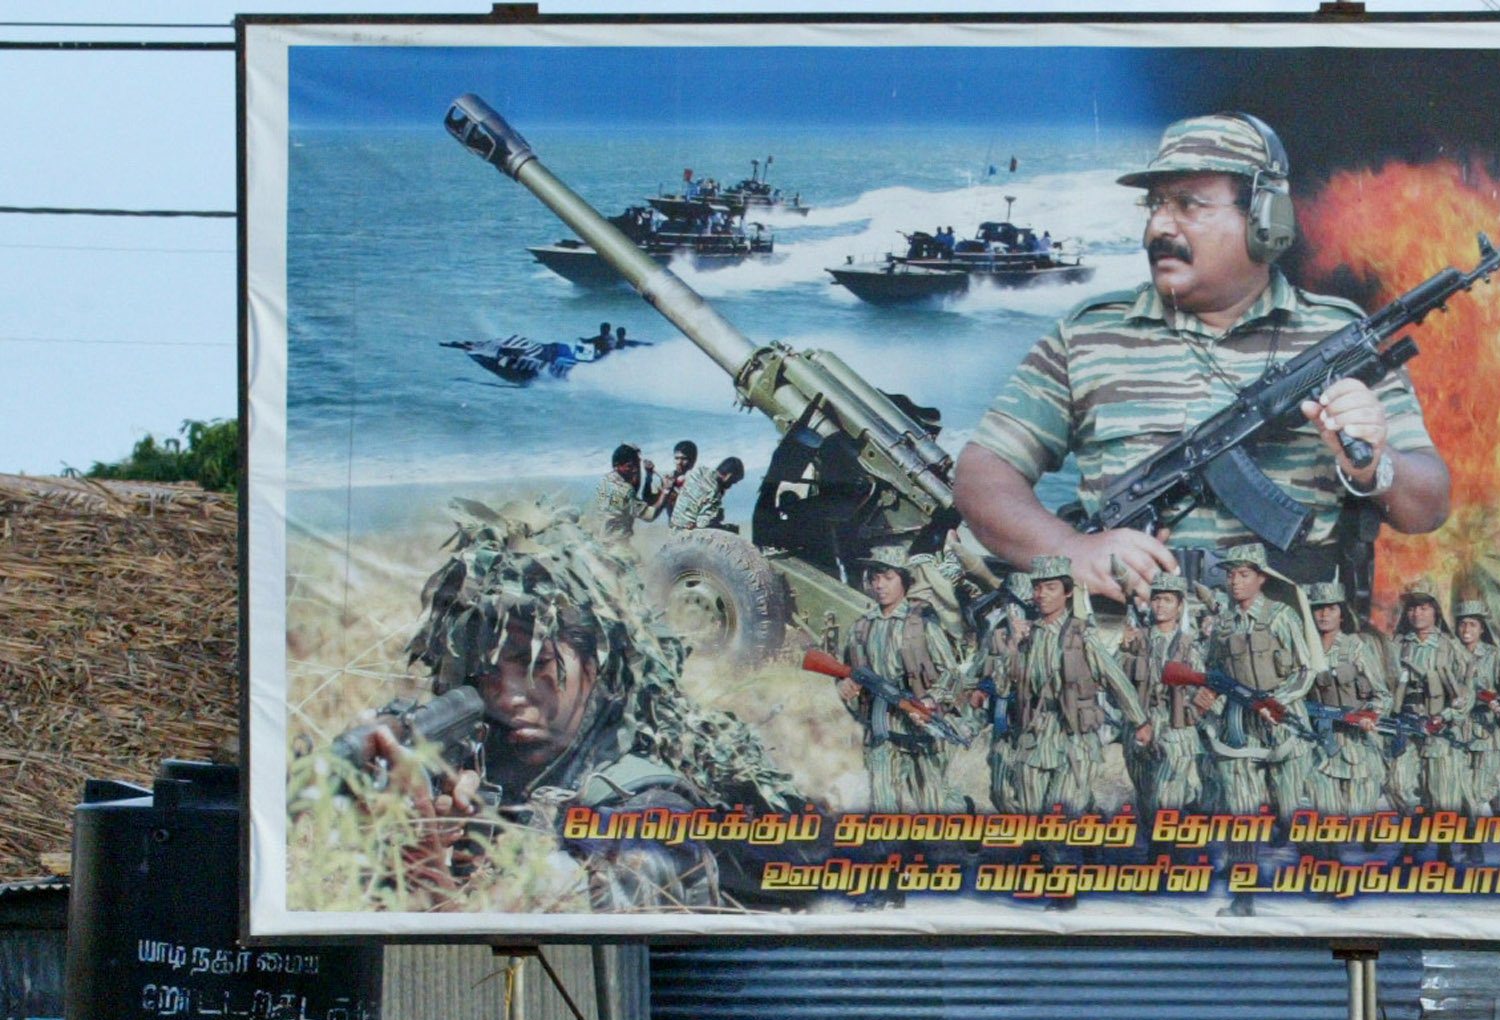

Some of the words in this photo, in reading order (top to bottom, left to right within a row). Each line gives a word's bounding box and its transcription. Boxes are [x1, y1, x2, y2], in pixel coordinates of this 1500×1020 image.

[564, 804, 822, 846] போரெடுக்கும்
[833, 803, 1137, 848] தலைவனுக்குத்
[1152, 804, 1277, 849] தோள்
[760, 854, 961, 896] ஊரெரிக்க
[975, 854, 1215, 898] வந்தவனின்
